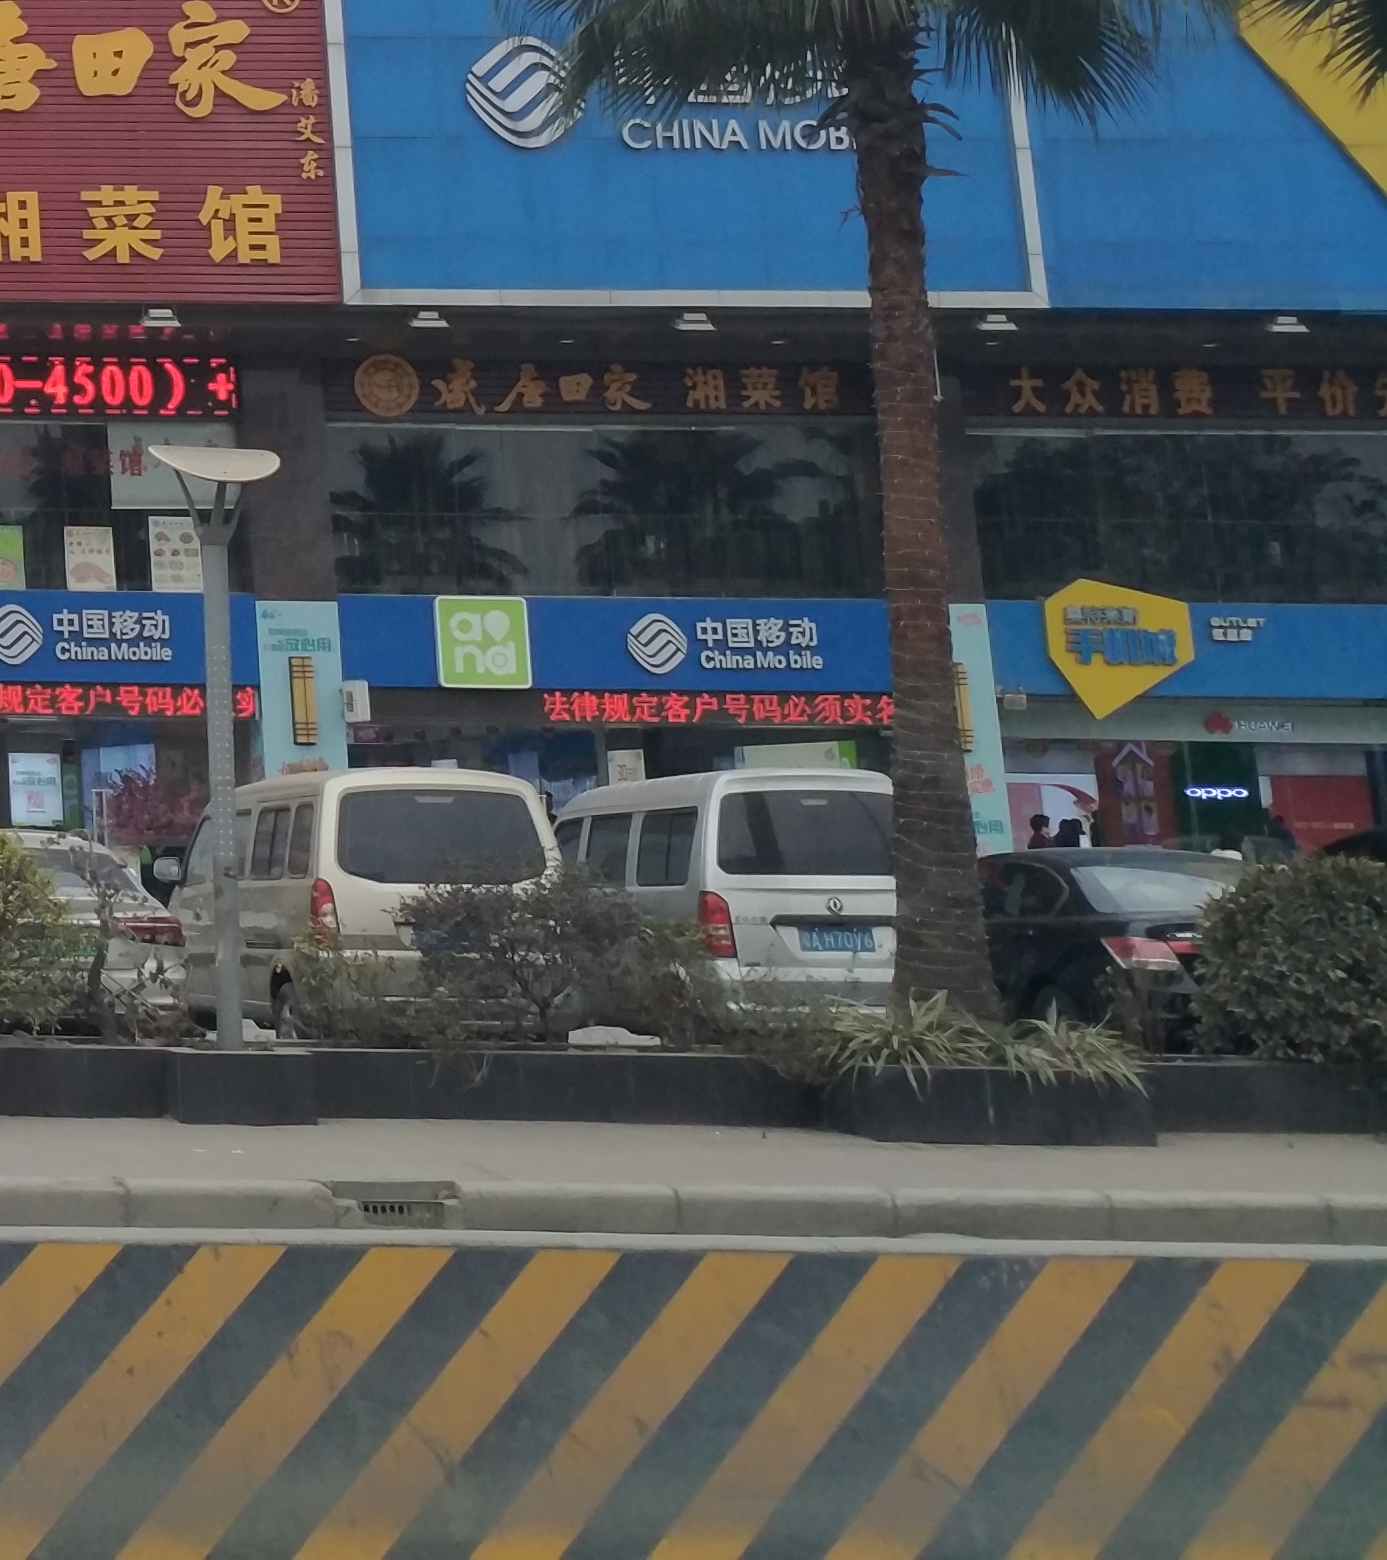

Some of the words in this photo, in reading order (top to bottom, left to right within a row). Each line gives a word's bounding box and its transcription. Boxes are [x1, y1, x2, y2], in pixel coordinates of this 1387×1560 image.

[621, 119, 748, 150] CHINA
[683, 366, 841, 412] 湘菜馆
[1008, 366, 1215, 418] 大众消费
[52, 609, 171, 641] 中国移动
[696, 617, 818, 648] 中国移动
[55, 642, 109, 660] China
[110, 642, 172, 662] Mobile
[700, 650, 755, 670] China
